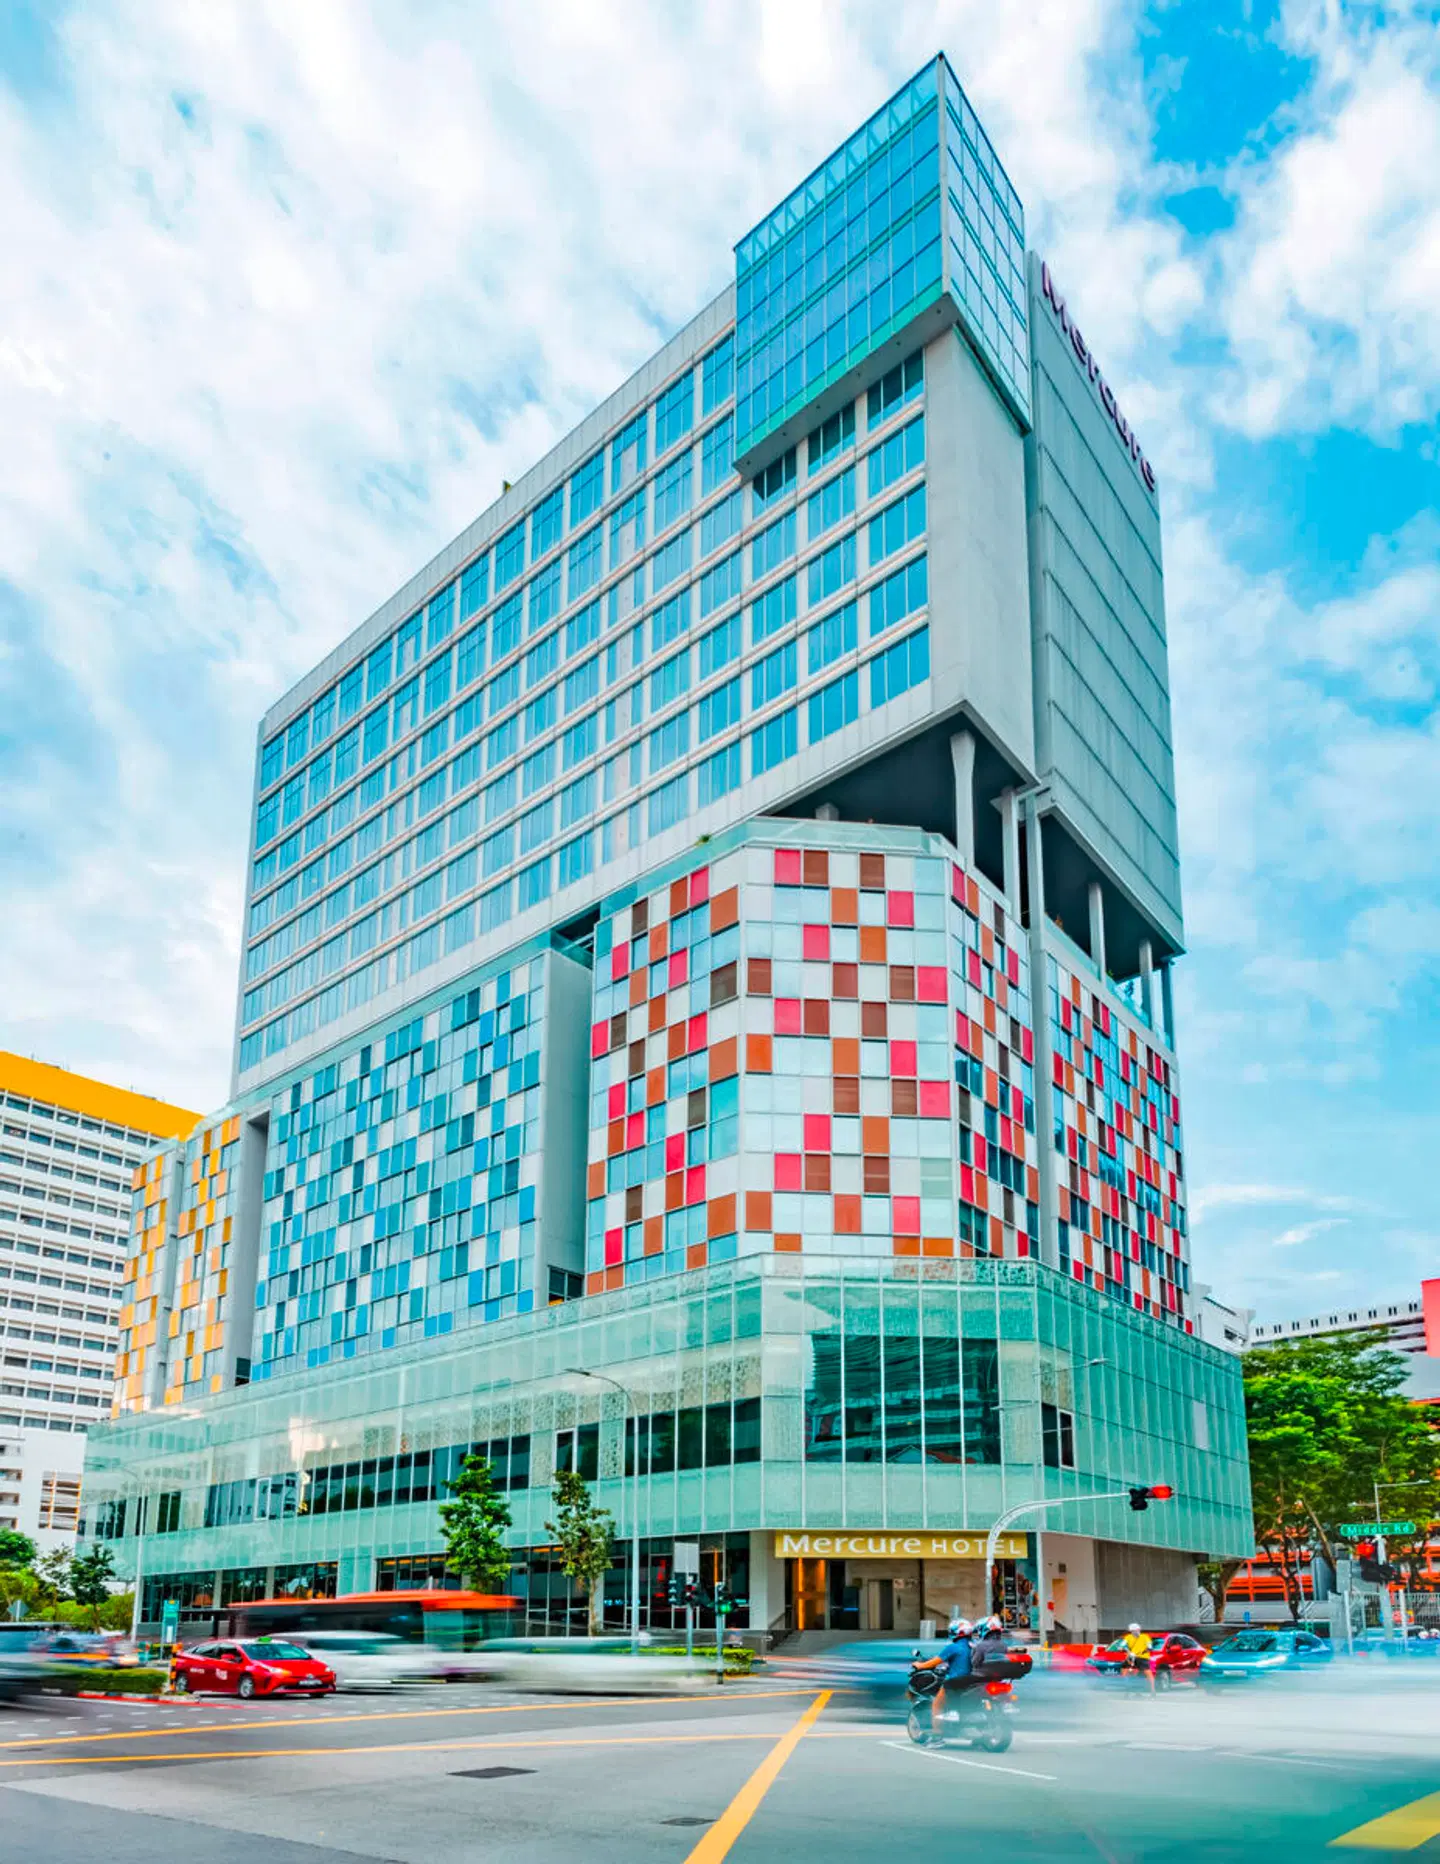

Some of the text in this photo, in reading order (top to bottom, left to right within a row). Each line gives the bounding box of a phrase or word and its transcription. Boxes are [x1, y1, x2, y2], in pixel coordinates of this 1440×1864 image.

[1042, 260, 1155, 492] Mercure
[1347, 1523, 1409, 1535] Middle Rd
[782, 1533, 1020, 1555] Mercure HOTEL
